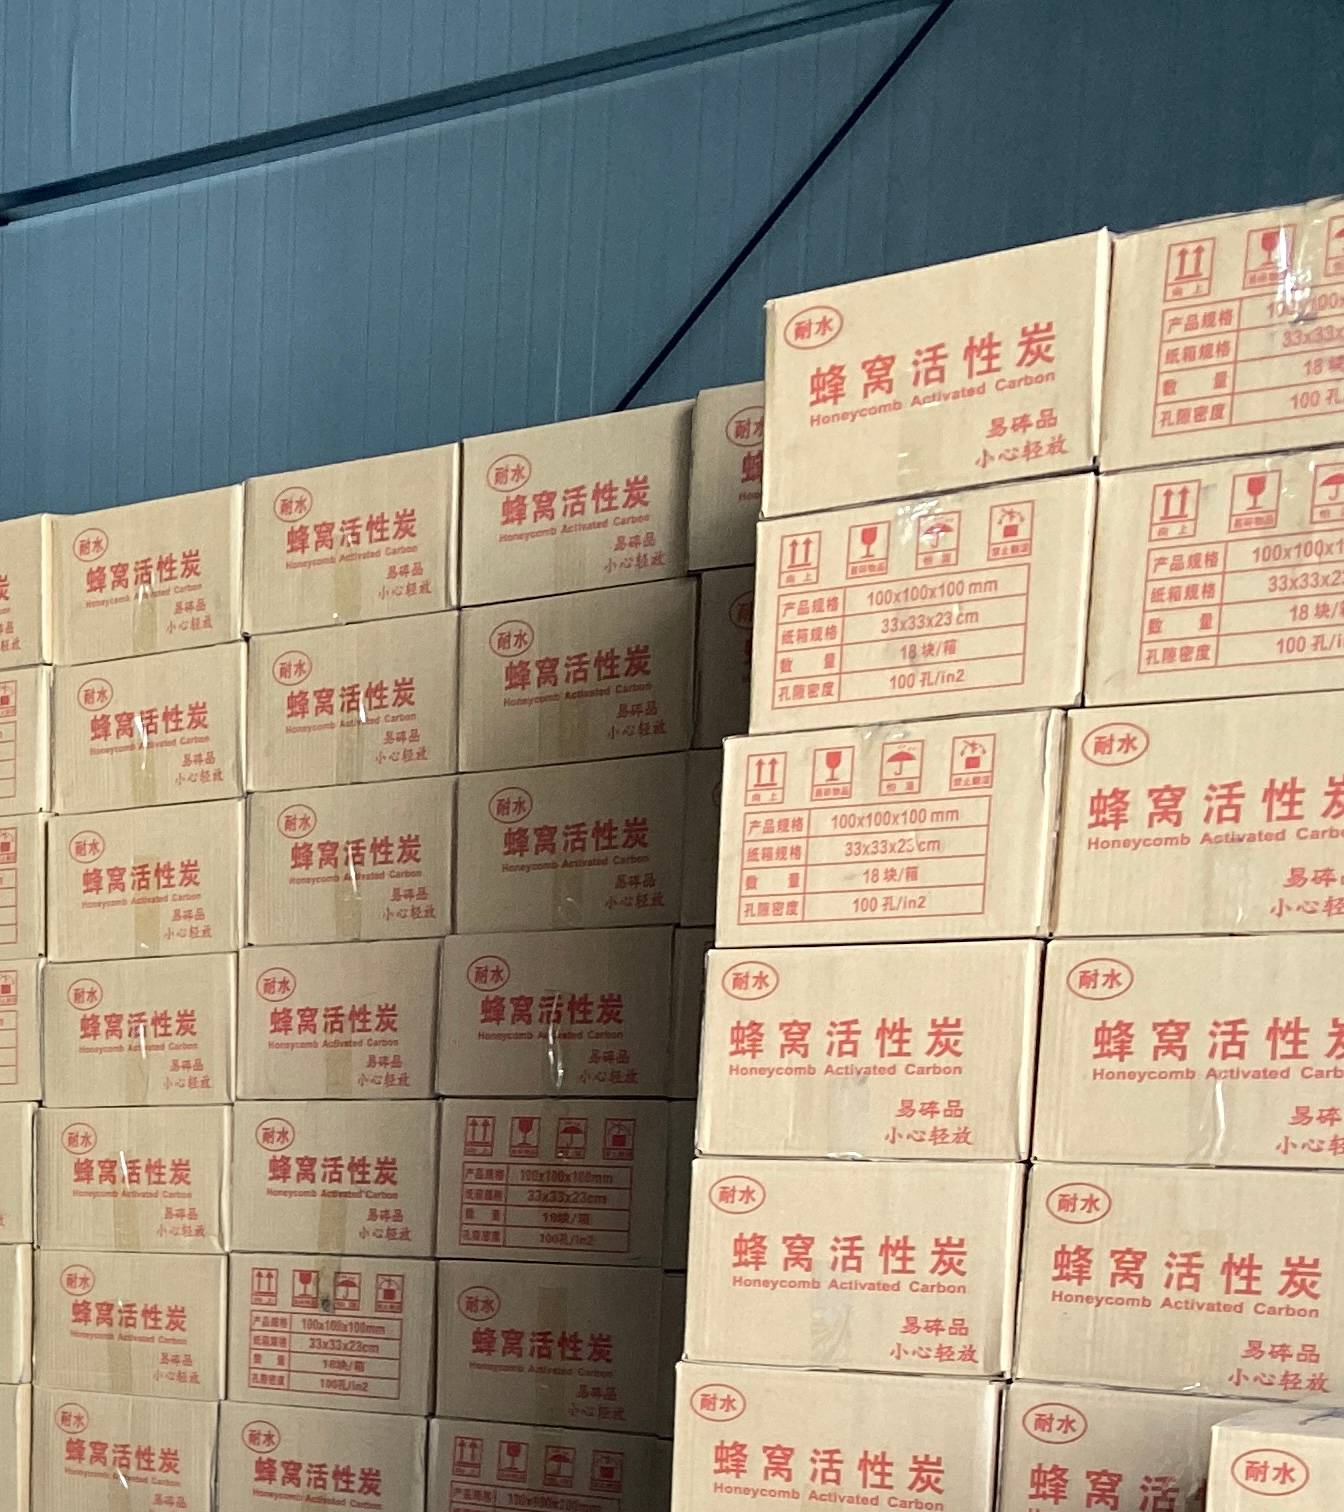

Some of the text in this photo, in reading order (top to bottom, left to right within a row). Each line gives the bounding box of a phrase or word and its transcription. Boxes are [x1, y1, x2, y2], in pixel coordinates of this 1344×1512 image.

[794, 318, 834, 340] 耐水
[809, 321, 1057, 408] 蜂窝活性炭
[809, 370, 1056, 427] Honeycomb Activated Carbon
[986, 410, 1057, 438] 易碎品
[975, 436, 1068, 469] 小心轻放
[500, 475, 651, 526] 蜂窝活性炭
[286, 509, 418, 555] 蜂窝活性炭
[782, 576, 999, 616] 产品规格 100x100x100 mm
[780, 607, 979, 646] 纸箱规格 33x33x23 cm
[503, 645, 652, 691] 蜂窝活性炭
[889, 672, 914, 689] 100
[731, 971, 770, 991] 耐水
[270, 1003, 399, 1034] 蜂窝活性炭
[729, 1018, 964, 1059] 蜂窝活性炭
[729, 1063, 962, 1077] Honeycomb Activated Carbon
[896, 1099, 964, 1119] 易碎品
[884, 1126, 973, 1146] 小心轻放
[267, 1156, 399, 1187] 蜂窝活性炭
[1057, 1192, 1102, 1214] 耐水
[1051, 1244, 1322, 1299] 蜂窝活性炭
[1051, 1291, 1320, 1318] Honeycomb Activated Carbon
[253, 1456, 383, 1495] 蜂窝活性炭
[714, 1440, 945, 1493] 蜂窝活性炭
